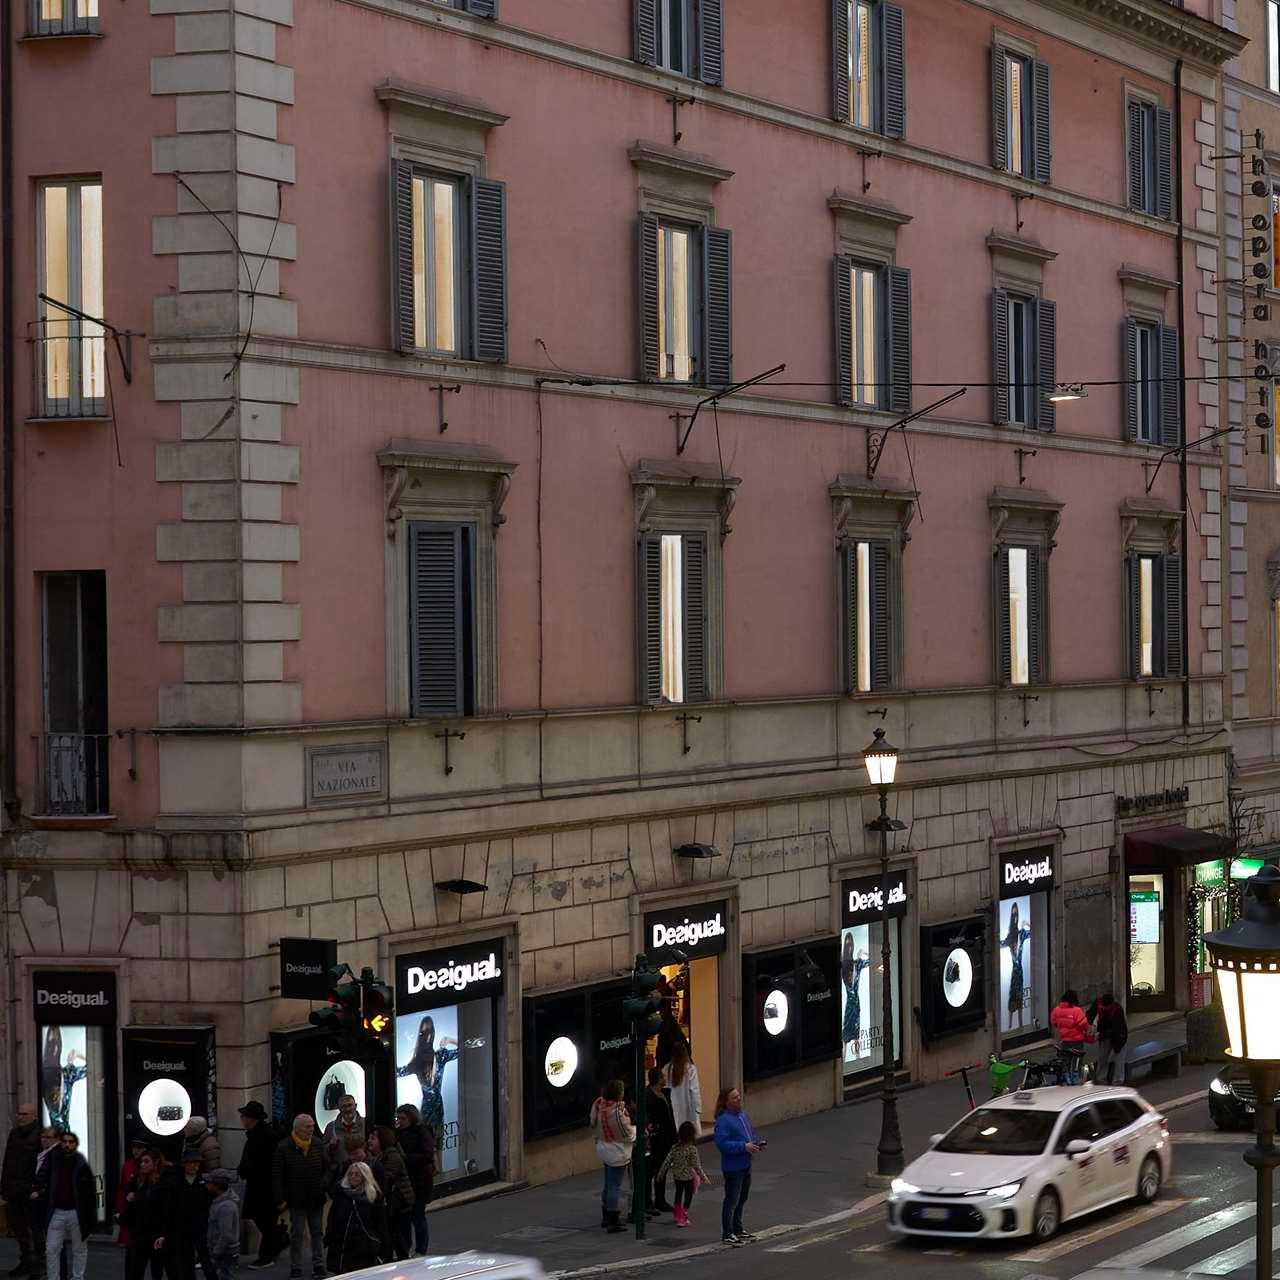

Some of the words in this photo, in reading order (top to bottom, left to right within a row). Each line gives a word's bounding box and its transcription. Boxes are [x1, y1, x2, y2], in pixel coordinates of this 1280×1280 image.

[1254, 338, 1274, 455] hotel
[338, 760, 356, 773] VIA
[317, 776, 377, 792] NAZIONALE
[1197, 867, 1223, 882] CHANGE
[861, 1025, 880, 1039] PARTY
